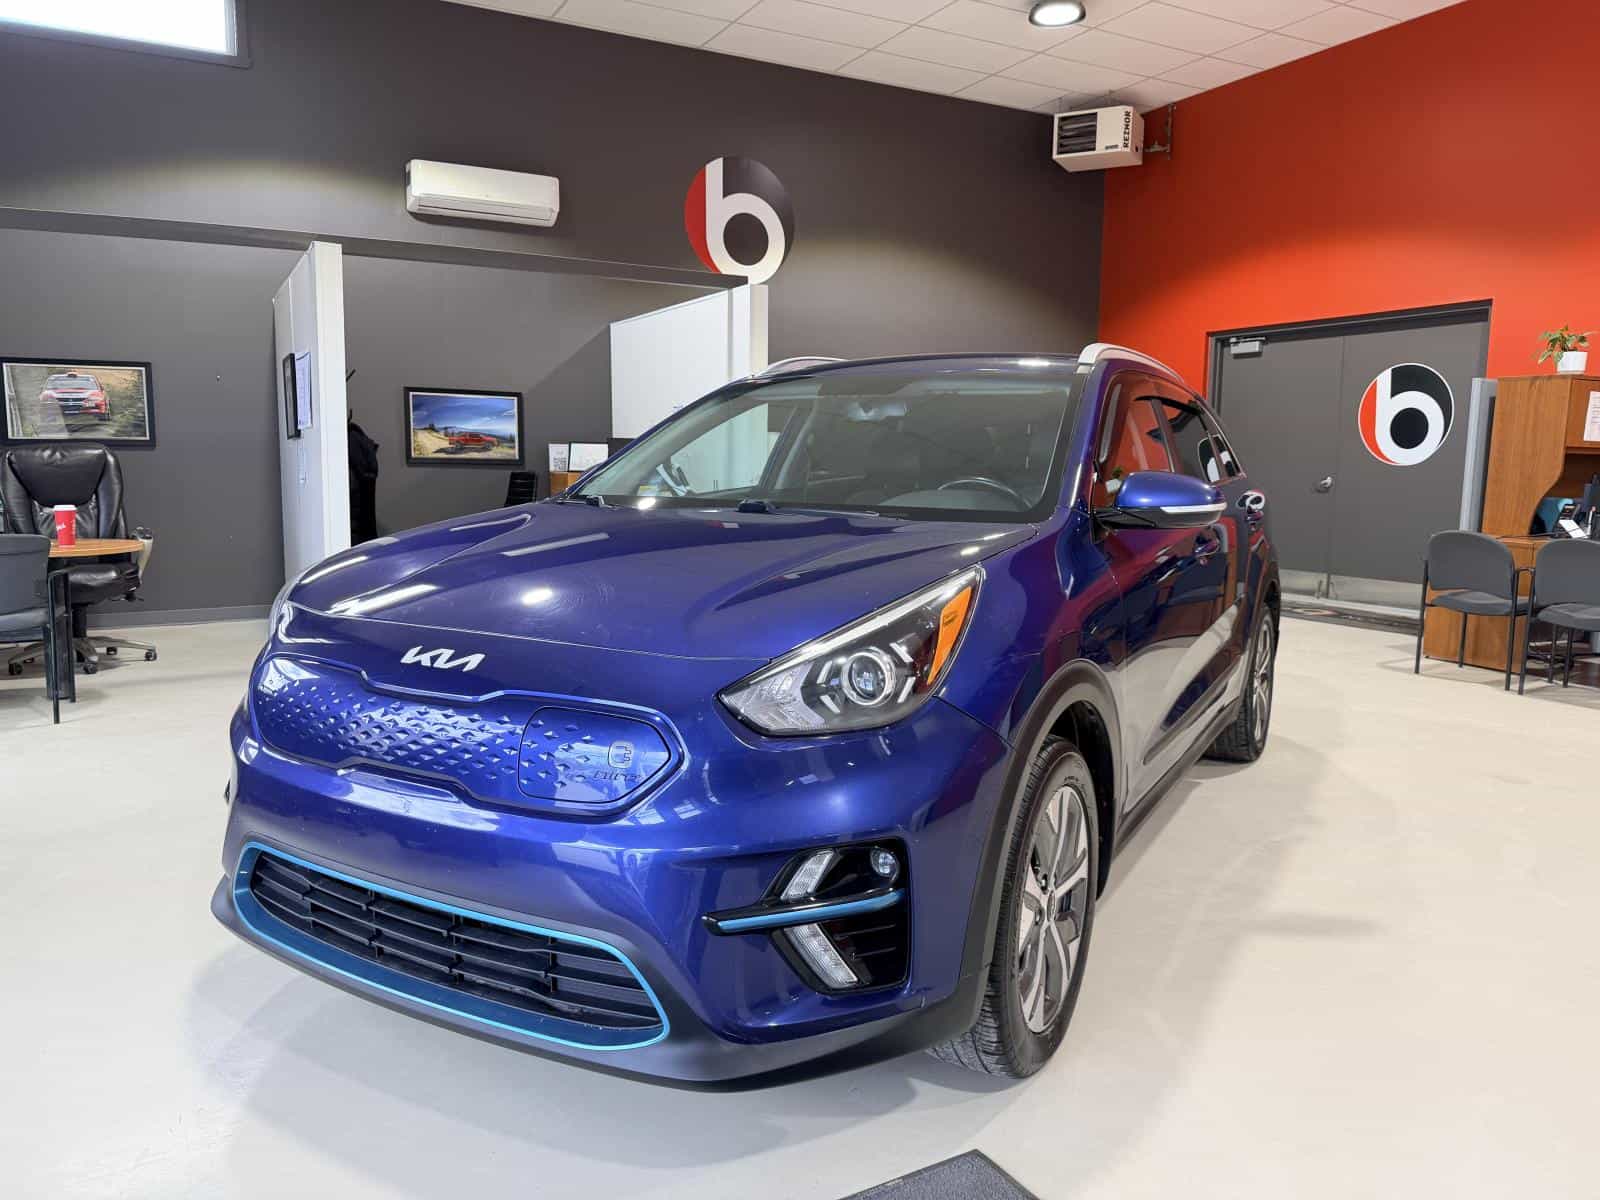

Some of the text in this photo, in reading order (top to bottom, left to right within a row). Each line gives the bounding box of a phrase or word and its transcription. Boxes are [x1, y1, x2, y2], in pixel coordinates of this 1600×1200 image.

[705, 157, 786, 285] b
[1375, 367, 1445, 466] b
[400, 645, 486, 672] KIA
